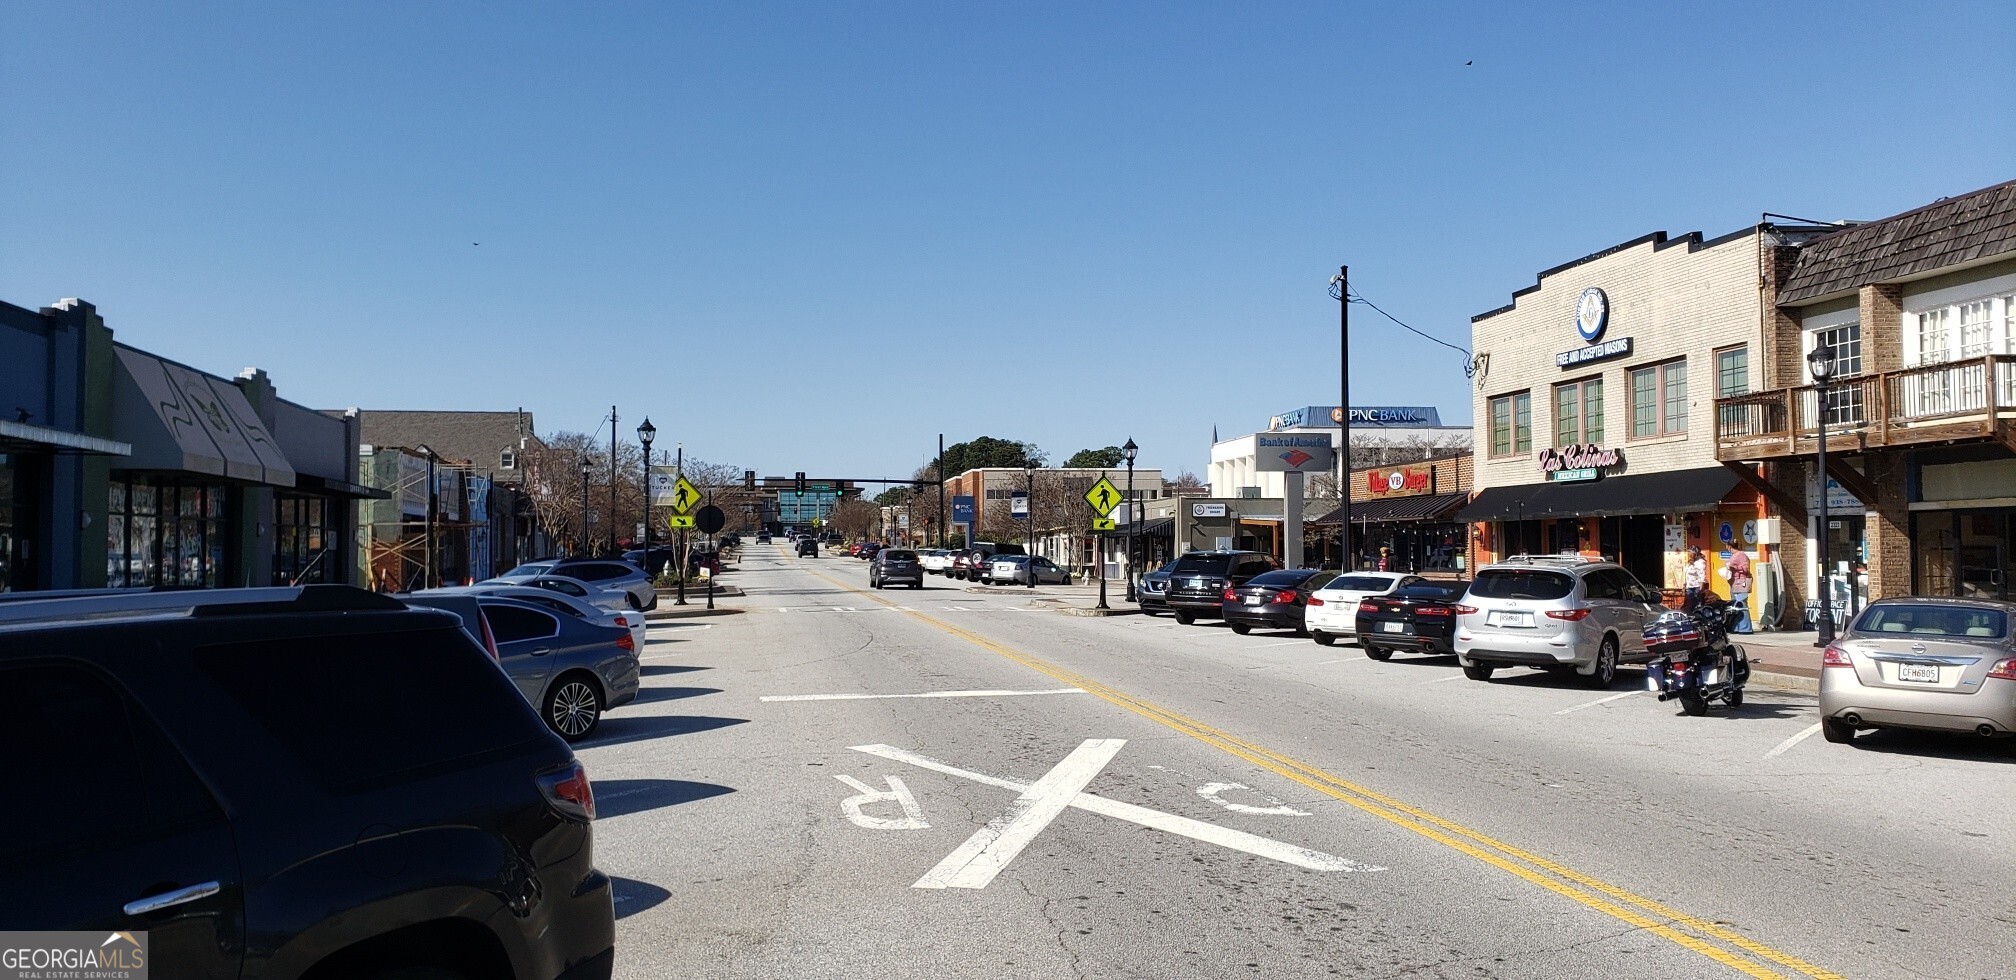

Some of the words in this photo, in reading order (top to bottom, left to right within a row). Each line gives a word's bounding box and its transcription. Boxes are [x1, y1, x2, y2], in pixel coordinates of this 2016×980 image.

[1557, 353, 1568, 365] FREE
[1569, 350, 1580, 363] AND
[1580, 344, 1604, 360] ACCEPTED
[1604, 338, 1628, 355] MASONS
[1350, 409, 1378, 421] PNC
[1380, 409, 1416, 421] BANK
[1259, 437, 1285, 447] Bank
[1285, 437, 1294, 447] of
[1294, 437, 1330, 447] America
[1539, 448, 1562, 472] Las
[1565, 444, 1618, 470] Colinas
[1558, 471, 1580, 480] MEXICAN
[1580, 469, 1595, 478] GRILL
[1368, 470, 1390, 496] Village
[1390, 476, 1402, 486] VB
[1404, 468, 1428, 493] Burger
[1830, 600, 1845, 609] PACE
[1805, 608, 1820, 623] FOR
